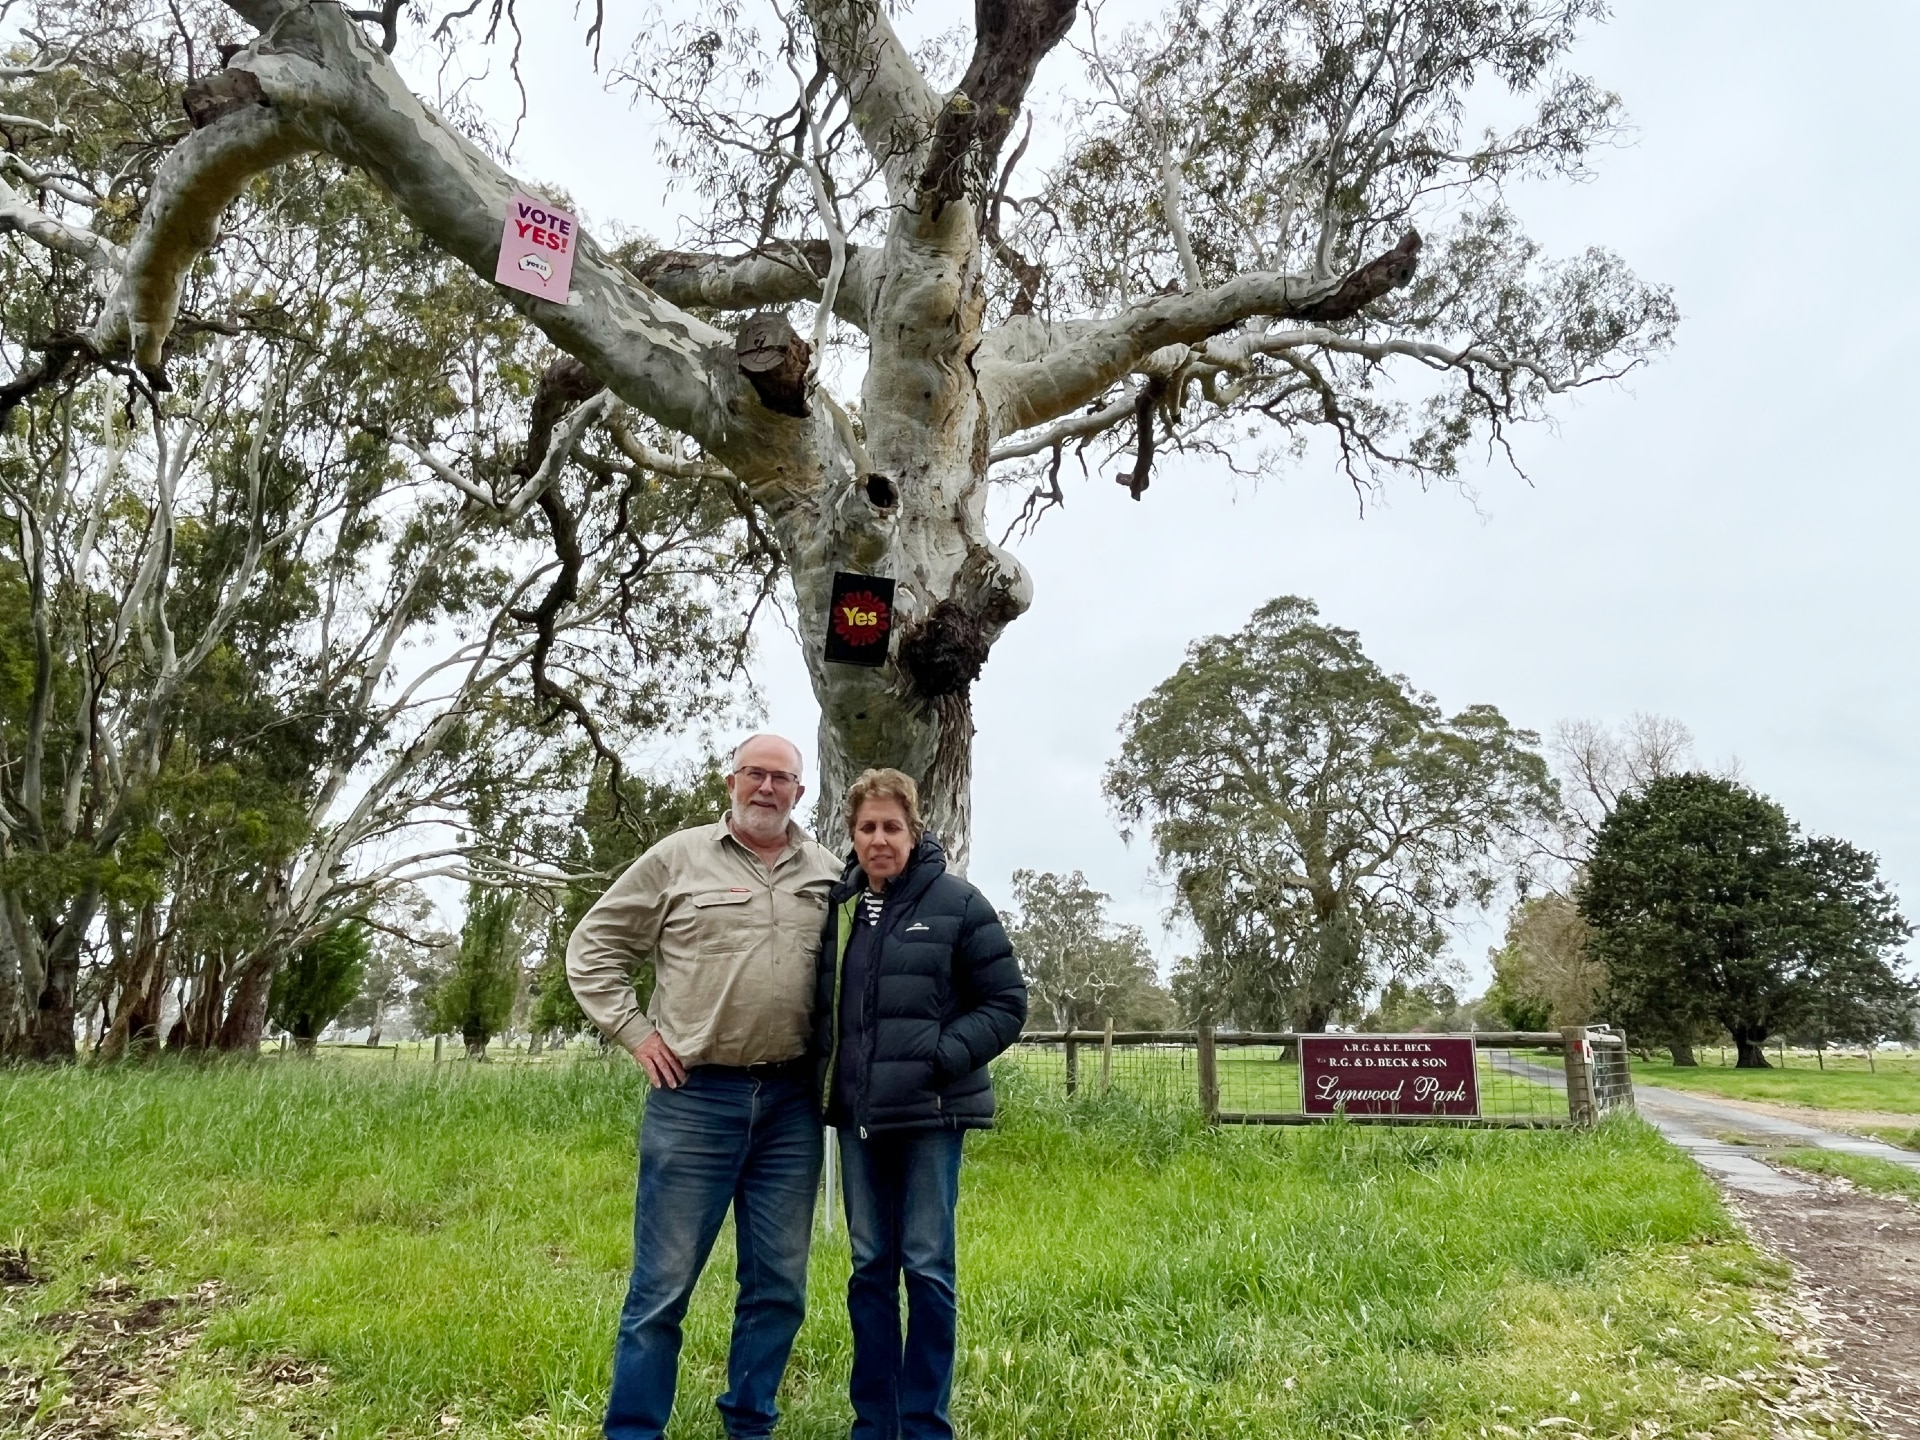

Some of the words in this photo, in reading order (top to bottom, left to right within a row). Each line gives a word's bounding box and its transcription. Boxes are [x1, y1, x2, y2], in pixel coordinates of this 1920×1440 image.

[518, 202, 571, 236] VOTE
[515, 219, 568, 253] YES!
[842, 606, 877, 626] Yes
[1343, 1043, 1372, 1052] A.R.G.
[1373, 1043, 1382, 1052] &
[1404, 1043, 1432, 1052] BECK
[1329, 1057, 1353, 1067] R.G.
[1354, 1057, 1363, 1067] &
[1411, 1057, 1420, 1067] &
[1422, 1057, 1448, 1067] SON
[1315, 1075, 1404, 1110] Lynwood
[1414, 1075, 1467, 1102] Park
